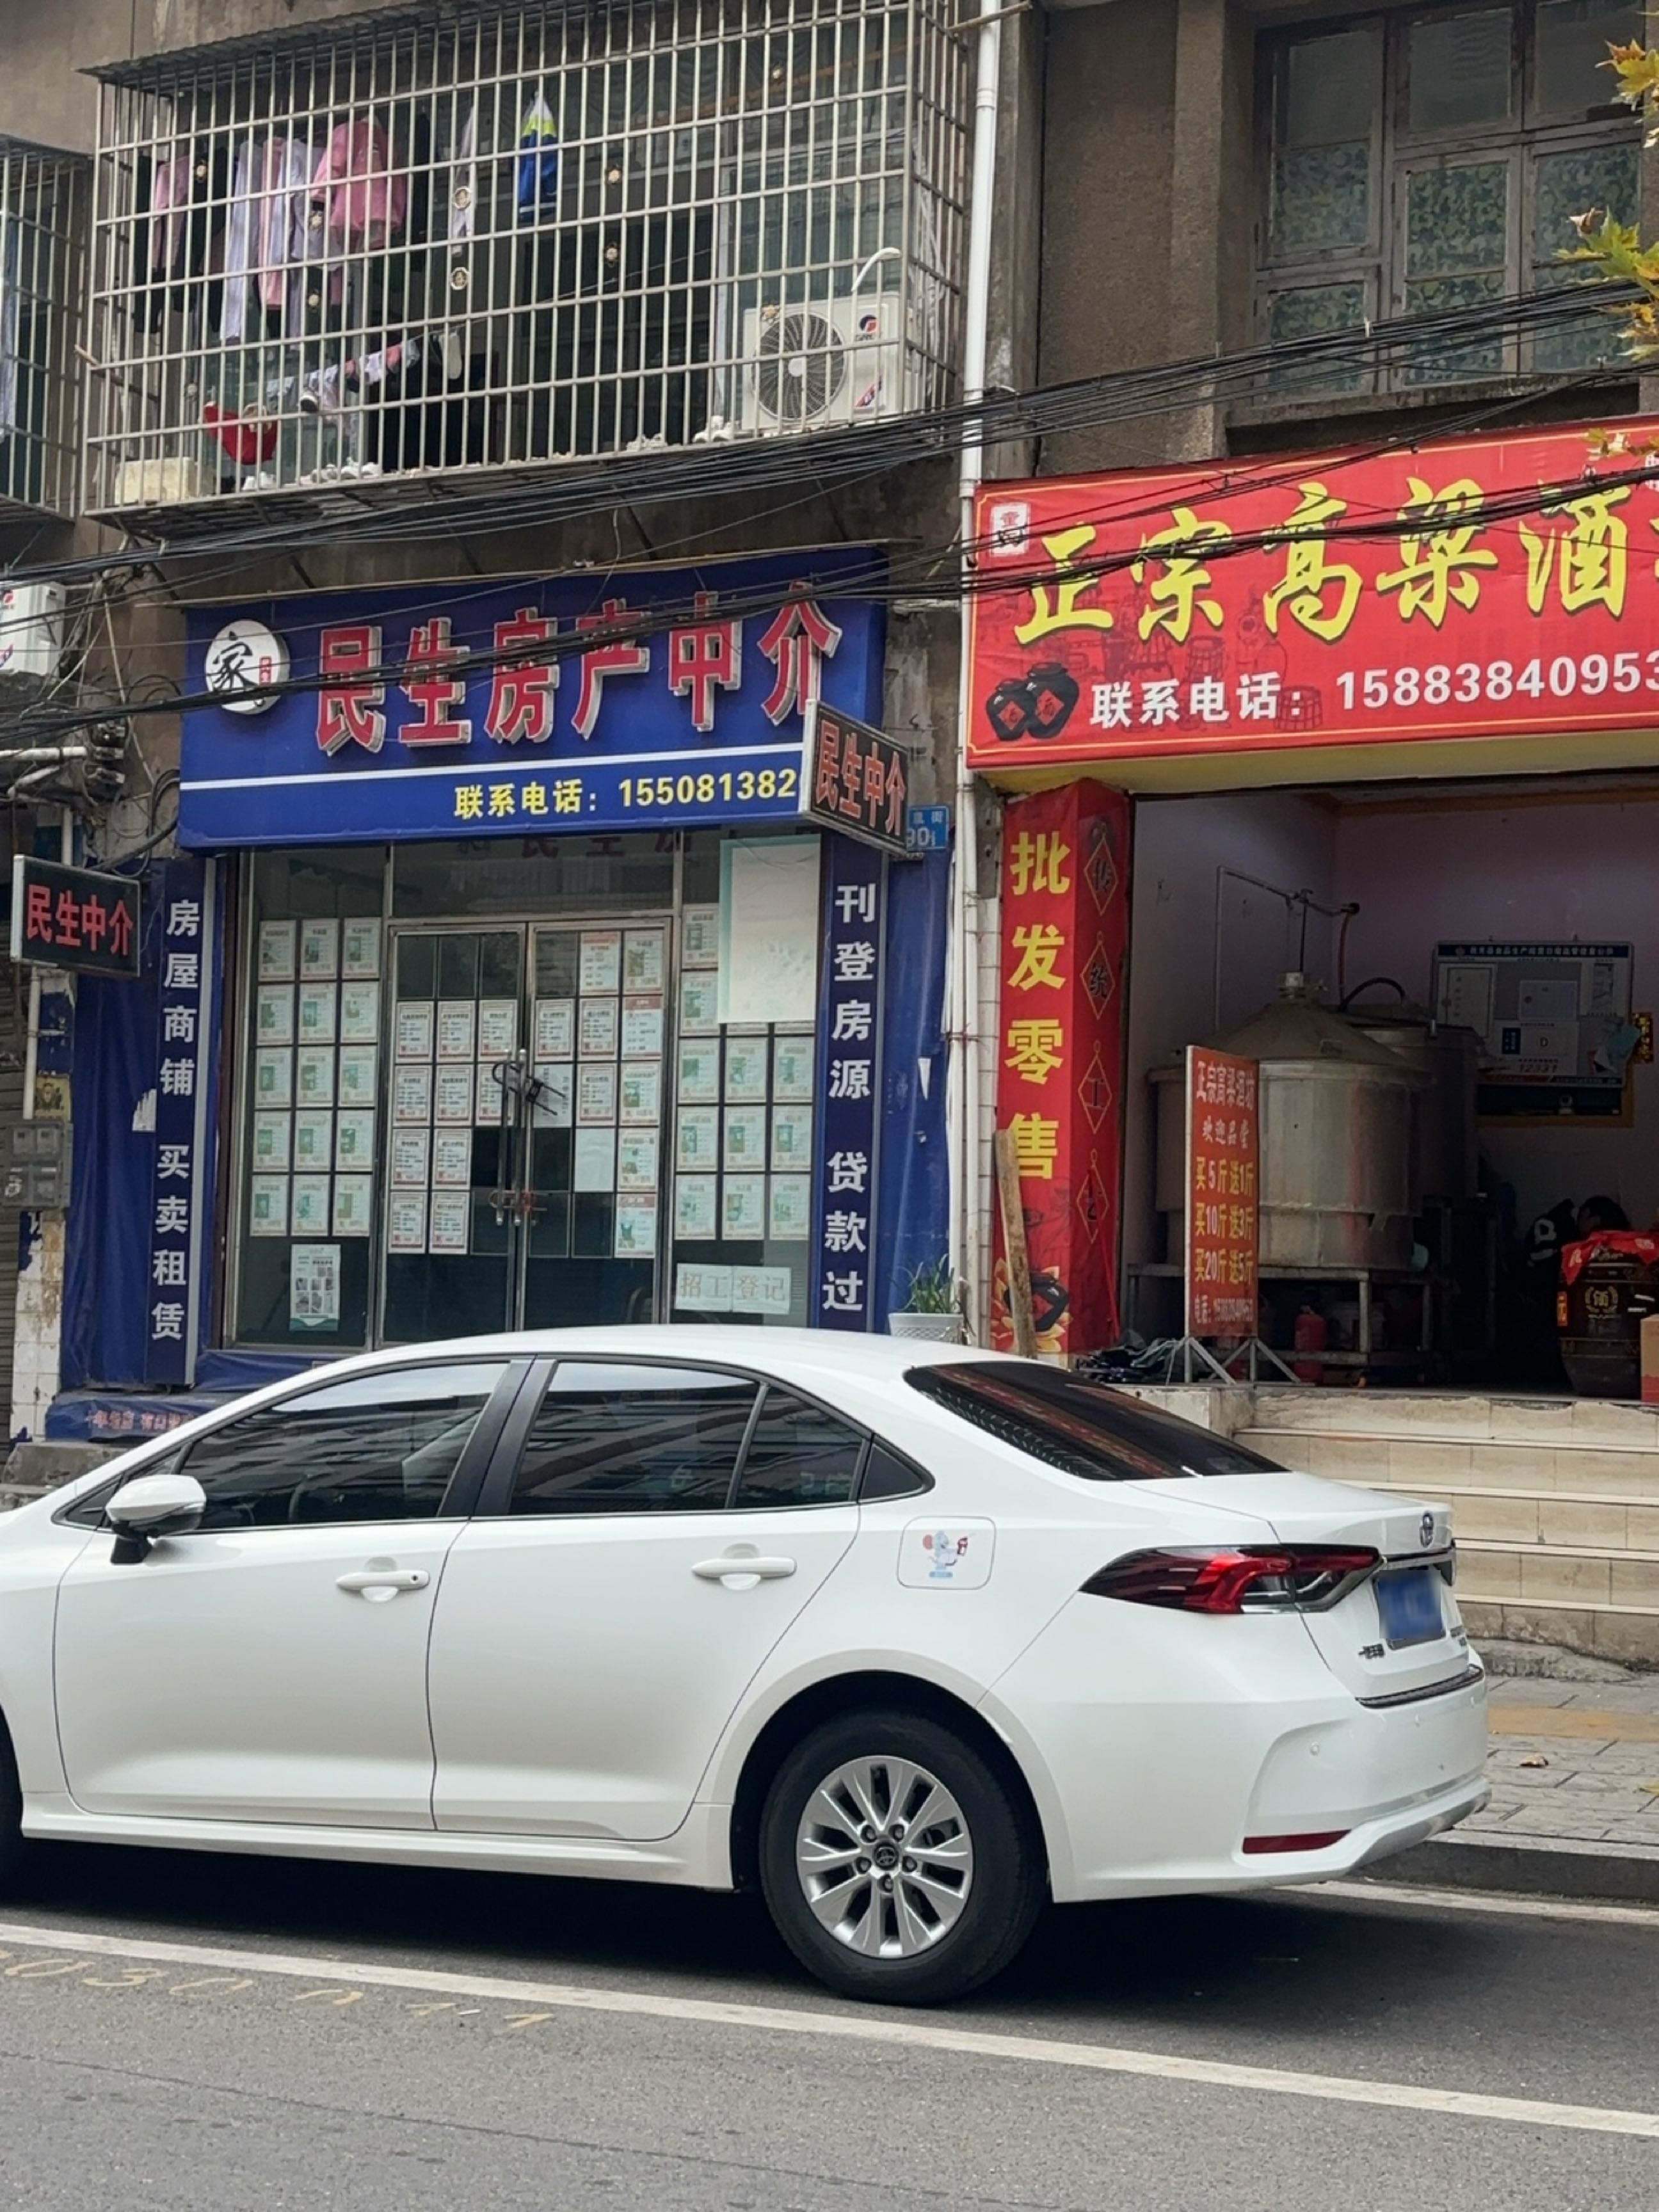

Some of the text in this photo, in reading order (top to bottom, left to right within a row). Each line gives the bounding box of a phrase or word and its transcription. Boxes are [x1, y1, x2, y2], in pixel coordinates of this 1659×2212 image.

[314, 581, 842, 757] 民生房产中介
[815, 718, 906, 837] 民生中介
[26, 883, 134, 957] 民生中介
[159, 900, 201, 1097] 房屋商铺
[828, 883, 877, 1101] 刊登房源
[1006, 831, 1071, 1180] 批发零售
[151, 1144, 190, 1341] 买卖租赁
[681, 1272, 786, 1302] 招工登记
[822, 1151, 869, 1313] 贷款过
